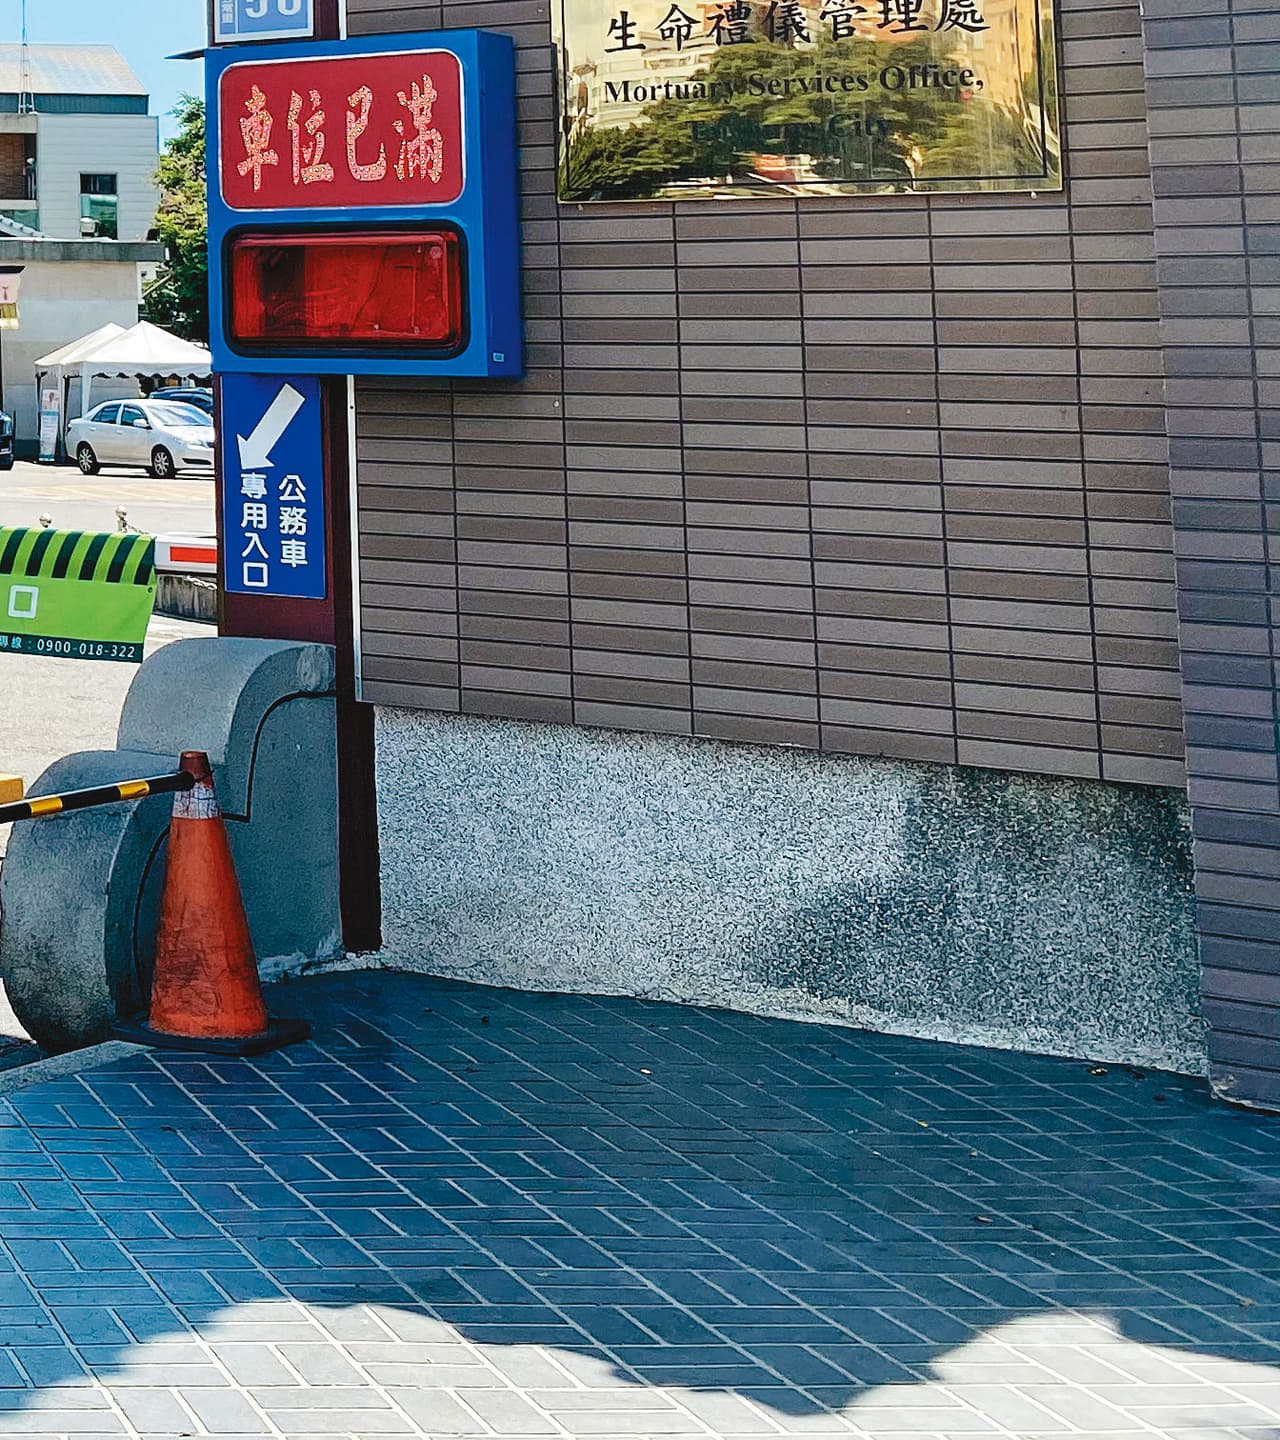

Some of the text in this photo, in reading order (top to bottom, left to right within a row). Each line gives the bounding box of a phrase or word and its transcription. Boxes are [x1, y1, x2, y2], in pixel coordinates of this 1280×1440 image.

[237, 73, 443, 192] 車位已滿
[604, 64, 984, 104] Mortuary Services Office,
[240, 472, 269, 588] 專用入口
[278, 474, 308, 568] 公務車
